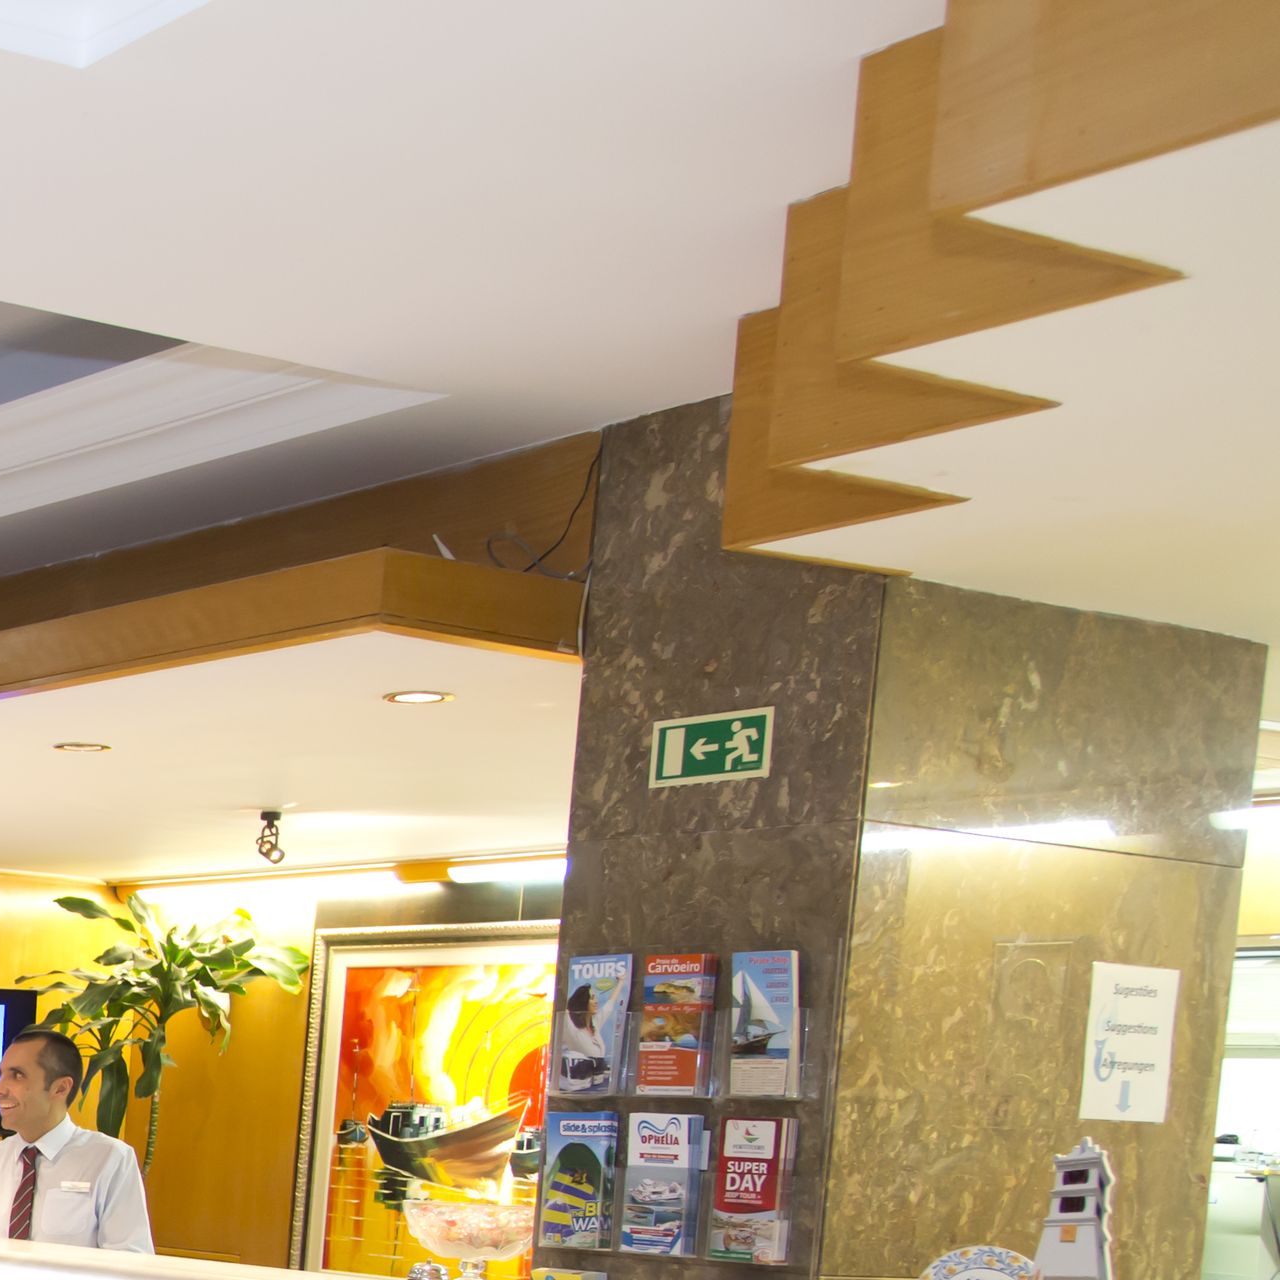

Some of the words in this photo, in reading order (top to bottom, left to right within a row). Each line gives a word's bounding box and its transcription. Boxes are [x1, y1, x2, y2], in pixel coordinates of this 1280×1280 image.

[571, 961, 626, 980] TOURS
[648, 961, 700, 973] Carvoeiro
[1105, 1020, 1158, 1036] Suggestions
[1101, 1058, 1155, 1074] Anregungen
[727, 1161, 768, 1174] SUPER
[726, 1173, 767, 1192] DAY
